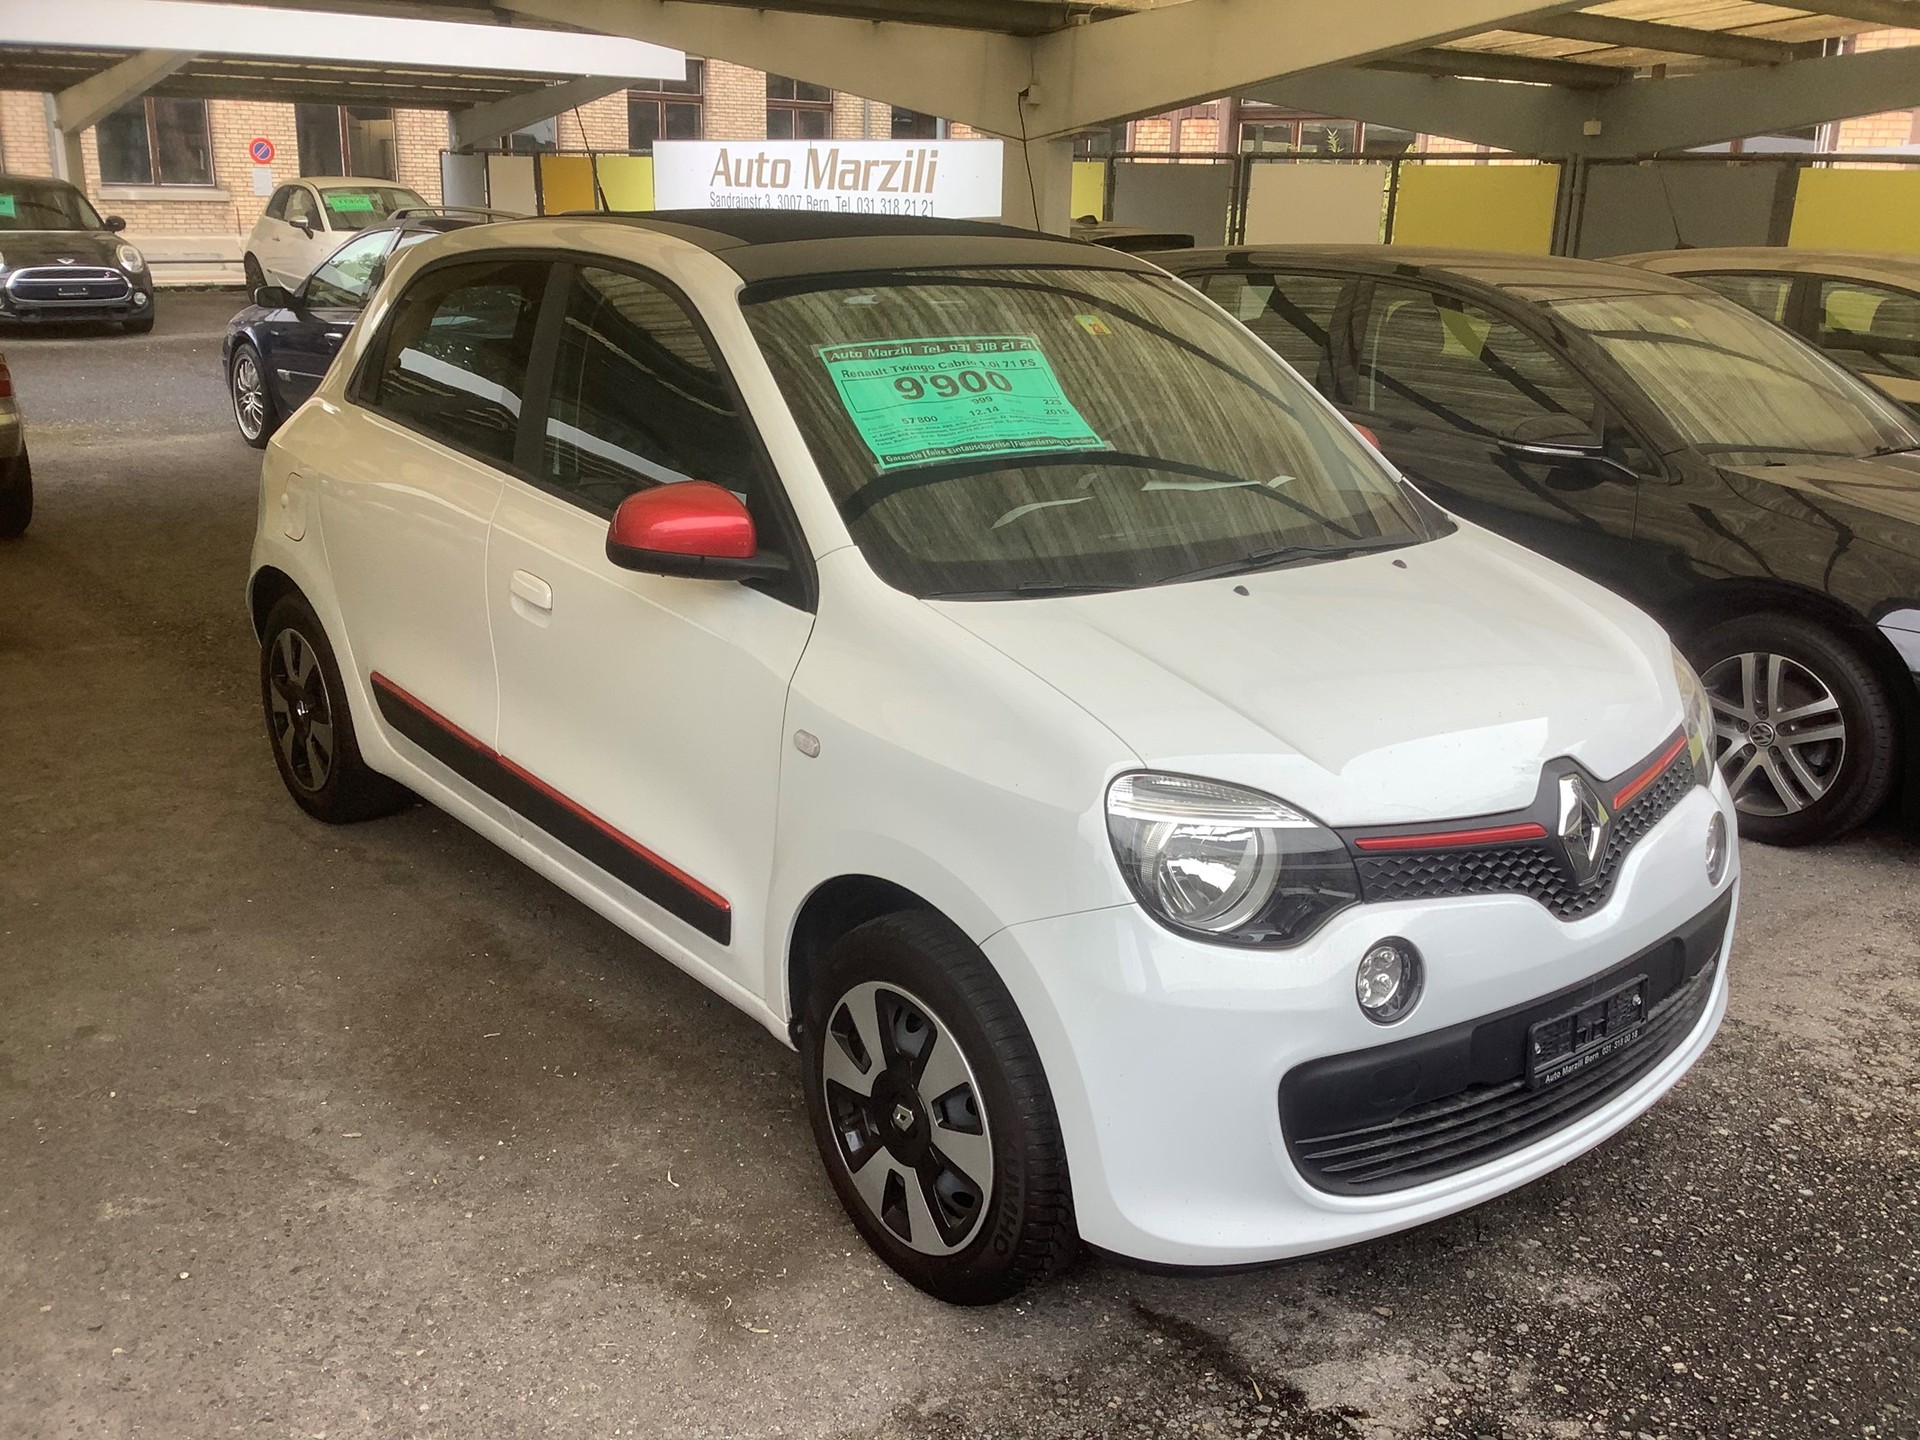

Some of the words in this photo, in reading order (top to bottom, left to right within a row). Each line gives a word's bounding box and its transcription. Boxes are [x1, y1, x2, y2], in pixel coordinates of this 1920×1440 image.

[709, 148, 791, 188] Auto
[804, 148, 938, 193] Marzili
[777, 194, 802, 211] 3007
[856, 197, 875, 214] 031
[880, 198, 900, 215] 318
[904, 199, 917, 216] 21
[921, 200, 934, 217] 21
[830, 350, 863, 360] Auto
[867, 346, 913, 358] Marzili
[921, 344, 945, 354] Tel.
[949, 343, 971, 352] 031
[975, 342, 997, 352] 318
[1001, 341, 1015, 351] 21
[1020, 341, 1033, 350] 21
[841, 368, 889, 379] Renault
[890, 362, 936, 373] Twingo
[938, 359, 978, 370] Cabrio
[1002, 360, 1017, 368] 71
[1019, 358, 1036, 367] PS
[893, 370, 1012, 400] 9'900
[968, 405, 1000, 417] 12.14
